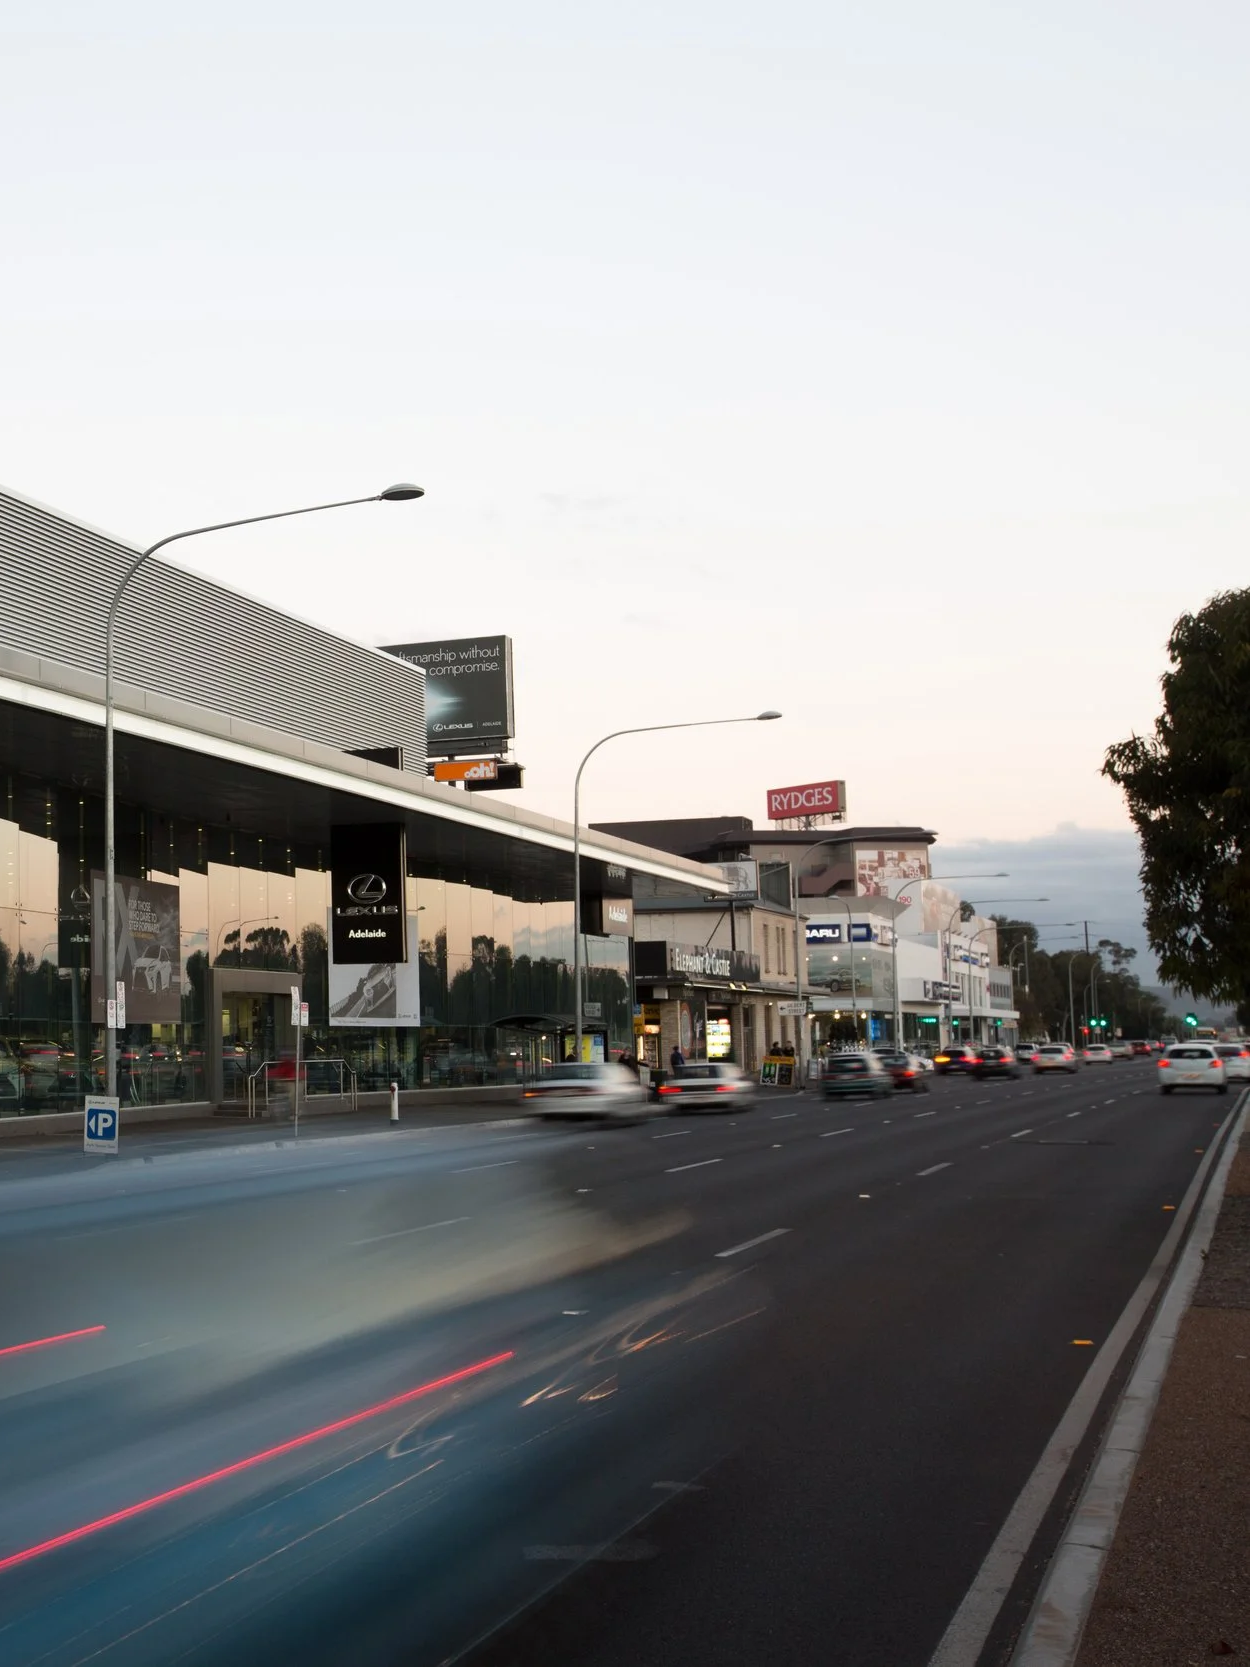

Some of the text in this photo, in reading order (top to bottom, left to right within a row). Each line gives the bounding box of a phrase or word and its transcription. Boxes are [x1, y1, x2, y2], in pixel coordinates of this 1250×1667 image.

[459, 644, 500, 660] without
[429, 660, 500, 676] compromise.
[771, 787, 833, 811] RYDGES
[336, 905, 399, 916] LEXUS
[348, 928, 387, 938] Adelaide
[97, 1112, 113, 1137] P
